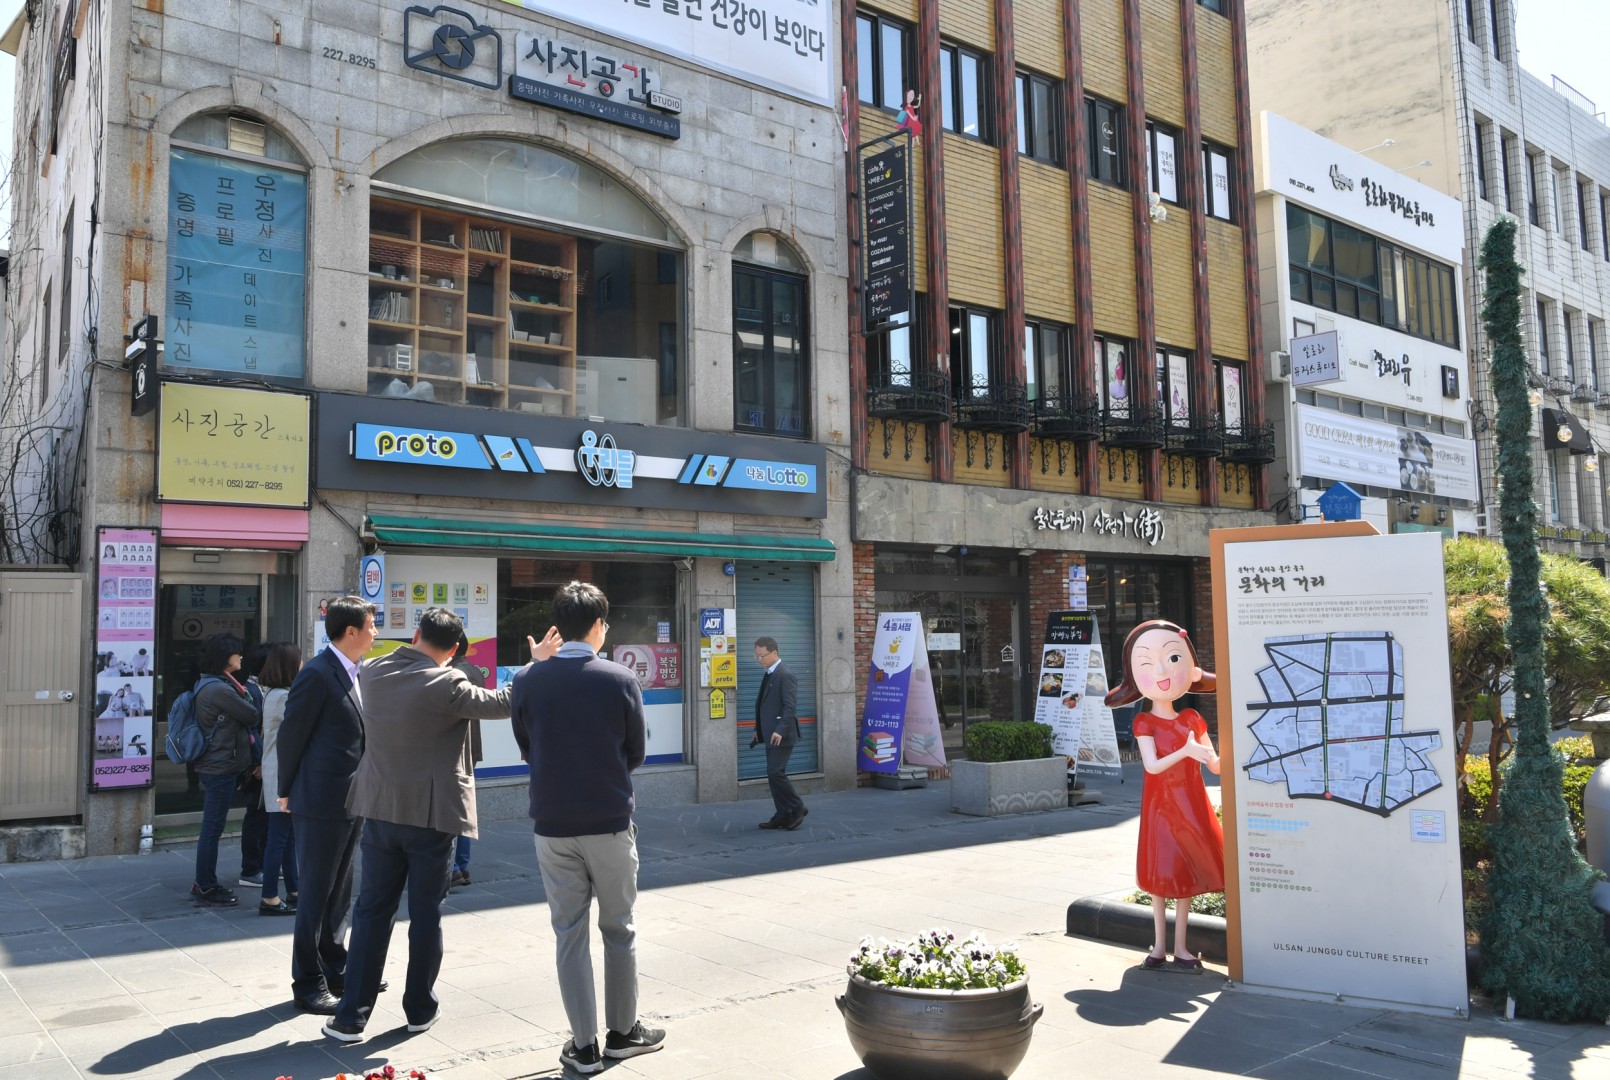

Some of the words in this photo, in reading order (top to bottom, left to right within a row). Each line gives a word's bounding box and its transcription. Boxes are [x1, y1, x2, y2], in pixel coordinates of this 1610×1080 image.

[710, 0, 767, 41] 건강이
[773, 15, 825, 62] 보인다
[322, 46, 376, 70] 227.8295
[525, 38, 651, 102] 사진공간
[516, 81, 550, 98] 증명사진
[553, 91, 586, 107] 가족사진
[589, 100, 620, 118] 우정사진
[623, 110, 645, 124] 프로필
[651, 94, 680, 109] STUDIO
[176, 191, 196, 239] 증명
[215, 175, 236, 247] 프로필
[253, 174, 277, 264] 우정사진
[172, 264, 194, 363] 가족사진
[171, 408, 276, 440] 사진공간
[375, 430, 457, 460] proto
[745, 465, 766, 482] 나눔
[766, 465, 809, 487] Lotto
[366, 569, 380, 584] 담배
[1238, 573, 1286, 594] 문화의
[1292, 575, 1325, 593] 거리
[704, 617, 721, 630] ADT
[659, 656, 677, 668] 복권
[659, 667, 678, 680] 명당
[715, 675, 734, 684] proto
[874, 719, 899, 729] 223-1113
[94, 763, 150, 777] 052)227-8295
[1273, 942, 1304, 953] ULSAN
[1306, 945, 1344, 957] JUNGGU
[1346, 949, 1390, 962] CULTURE
[1392, 954, 1430, 966] STREET
